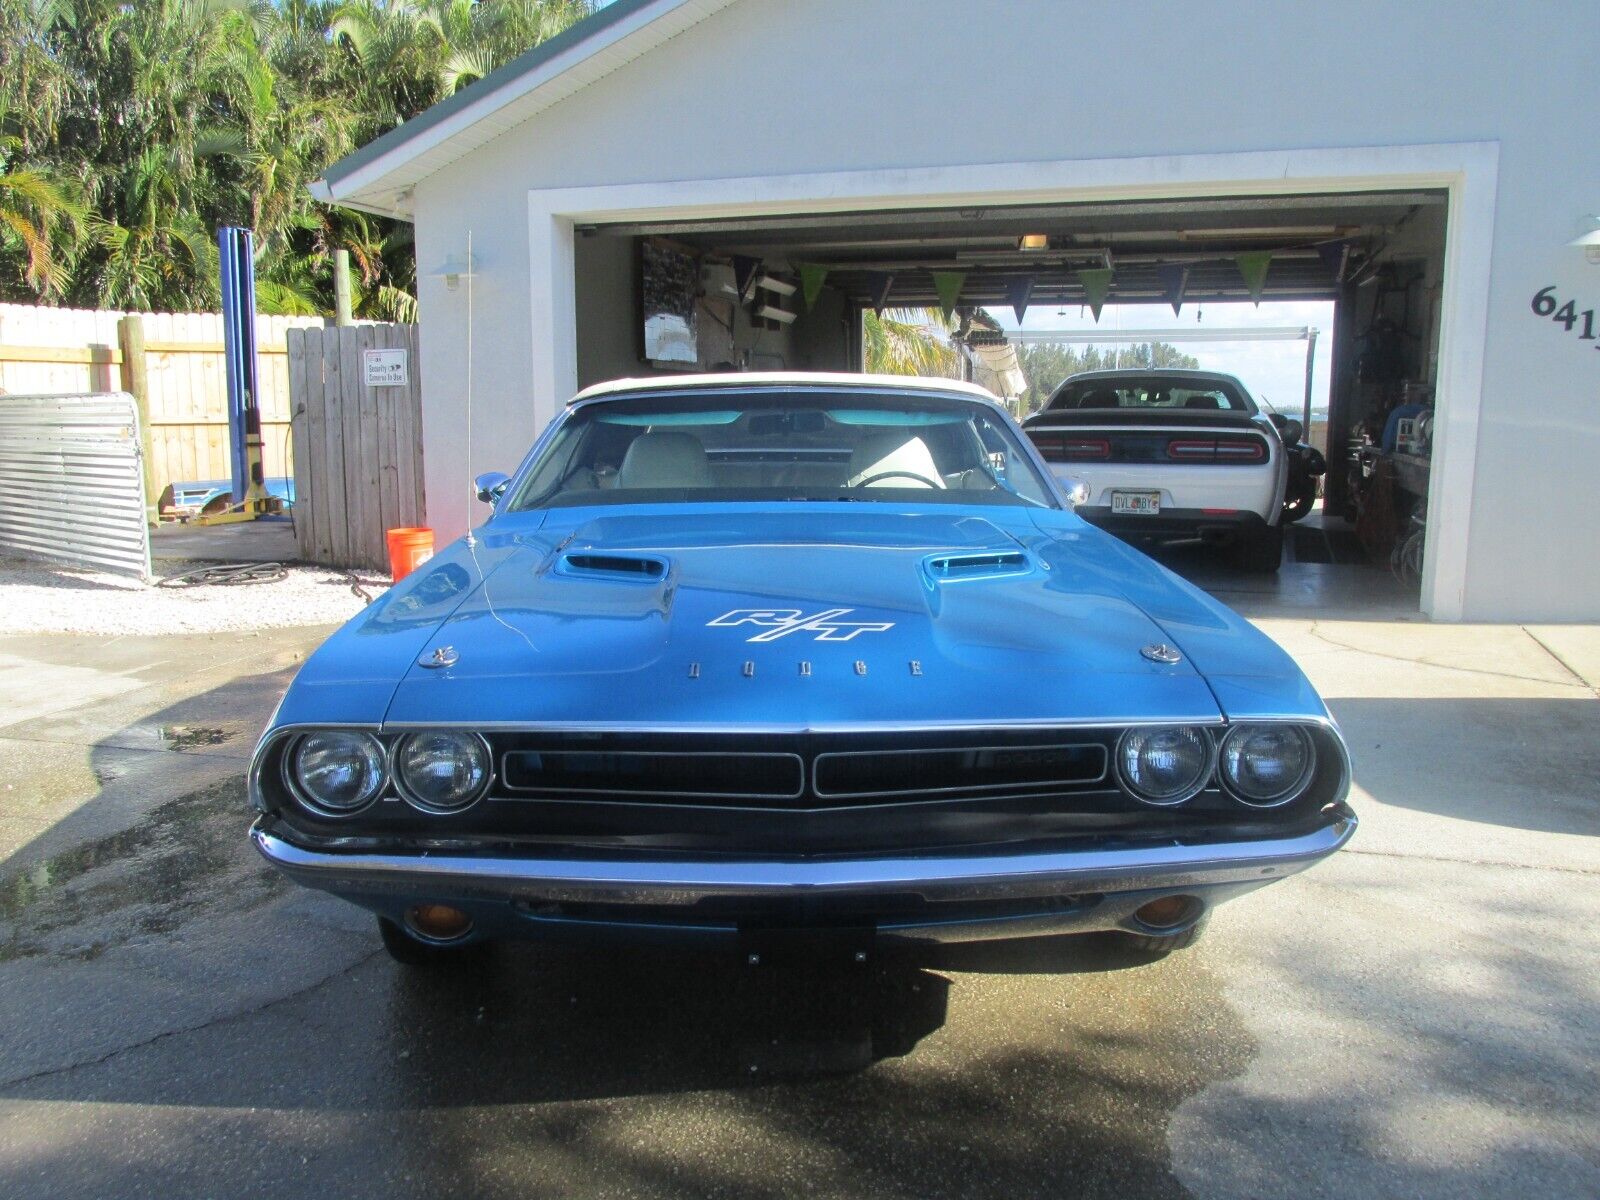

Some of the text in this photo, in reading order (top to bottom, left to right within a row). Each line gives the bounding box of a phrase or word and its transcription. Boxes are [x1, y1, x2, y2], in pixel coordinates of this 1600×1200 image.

[1531, 286, 1600, 351] 641
[369, 364, 387, 373] Security
[393, 373, 402, 381] Use
[705, 608, 896, 642] R/T
[688, 660, 922, 679] DODGE
